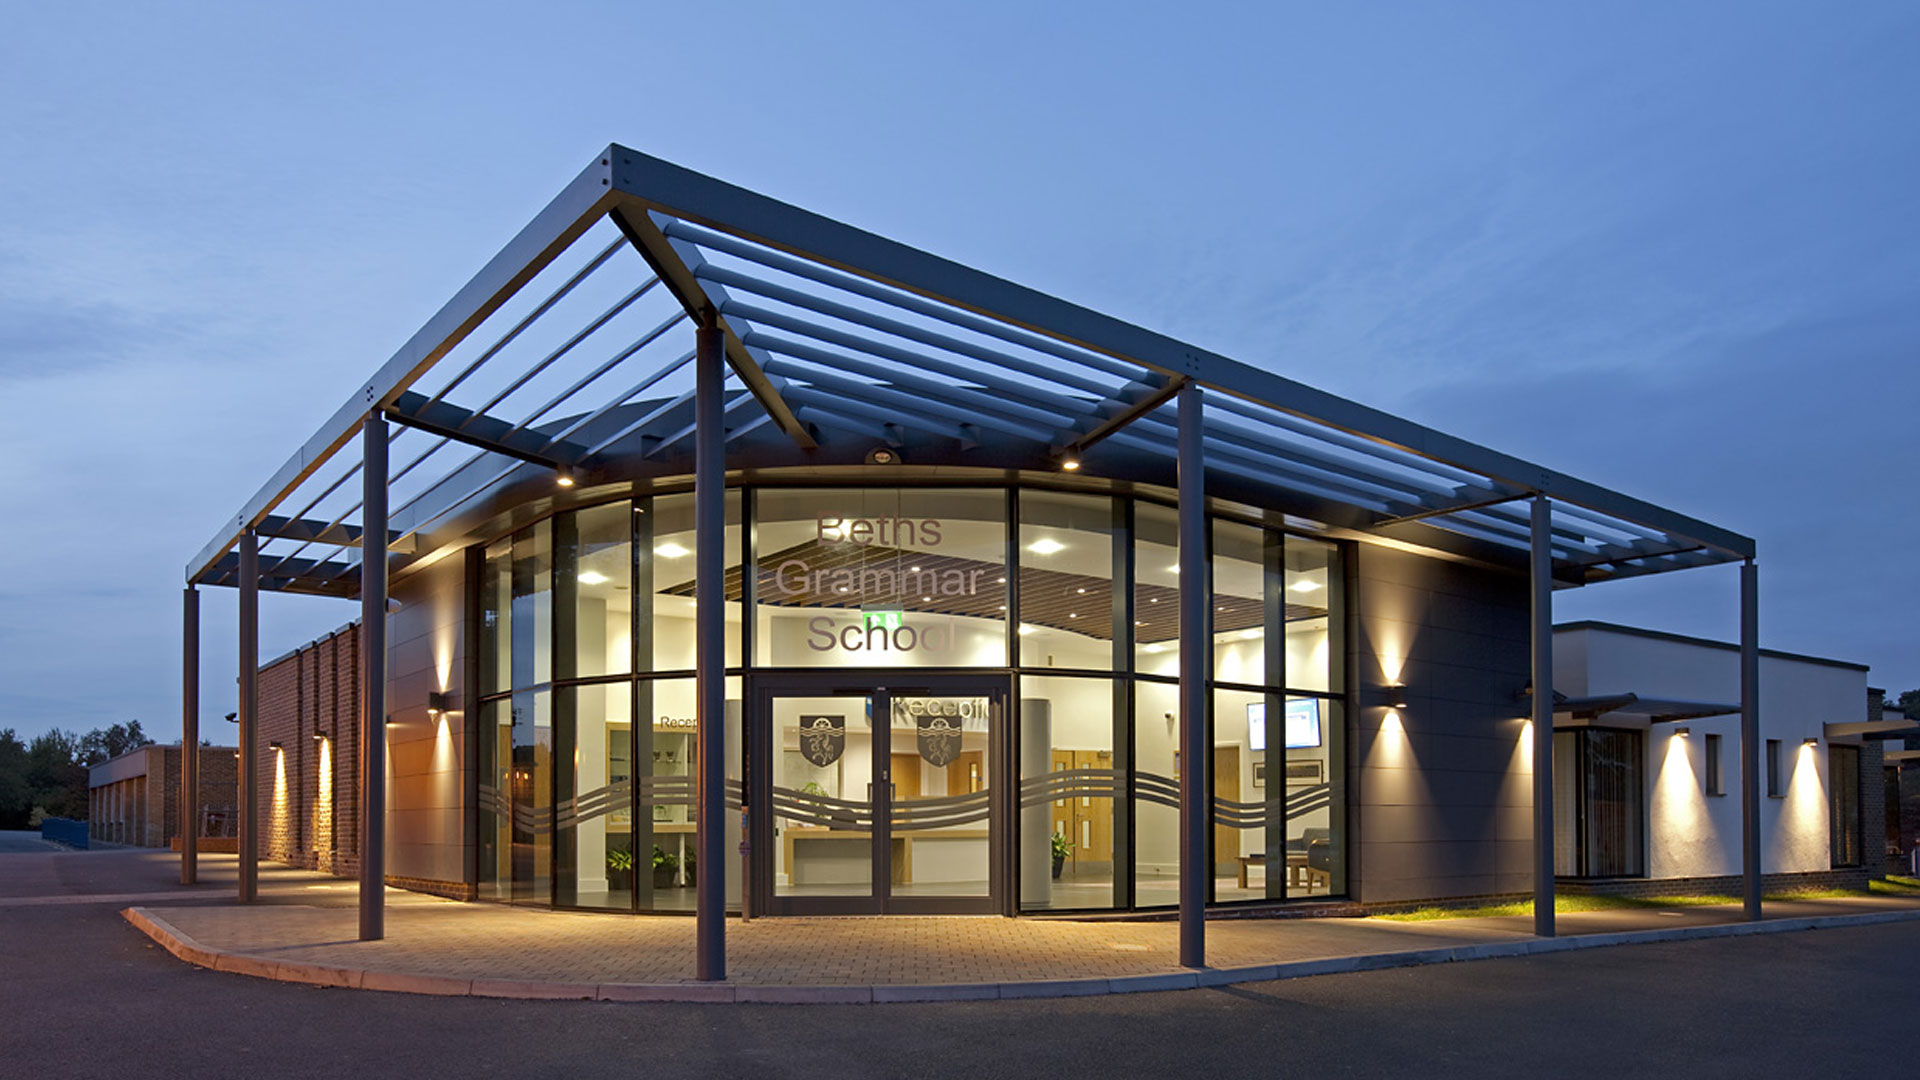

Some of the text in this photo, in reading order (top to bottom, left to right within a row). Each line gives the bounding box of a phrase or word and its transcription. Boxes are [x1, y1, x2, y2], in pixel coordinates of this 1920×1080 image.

[817, 511, 942, 547] Beths
[775, 560, 985, 596] Grammar
[807, 616, 956, 651] School
[660, 716, 697, 730] Recep
